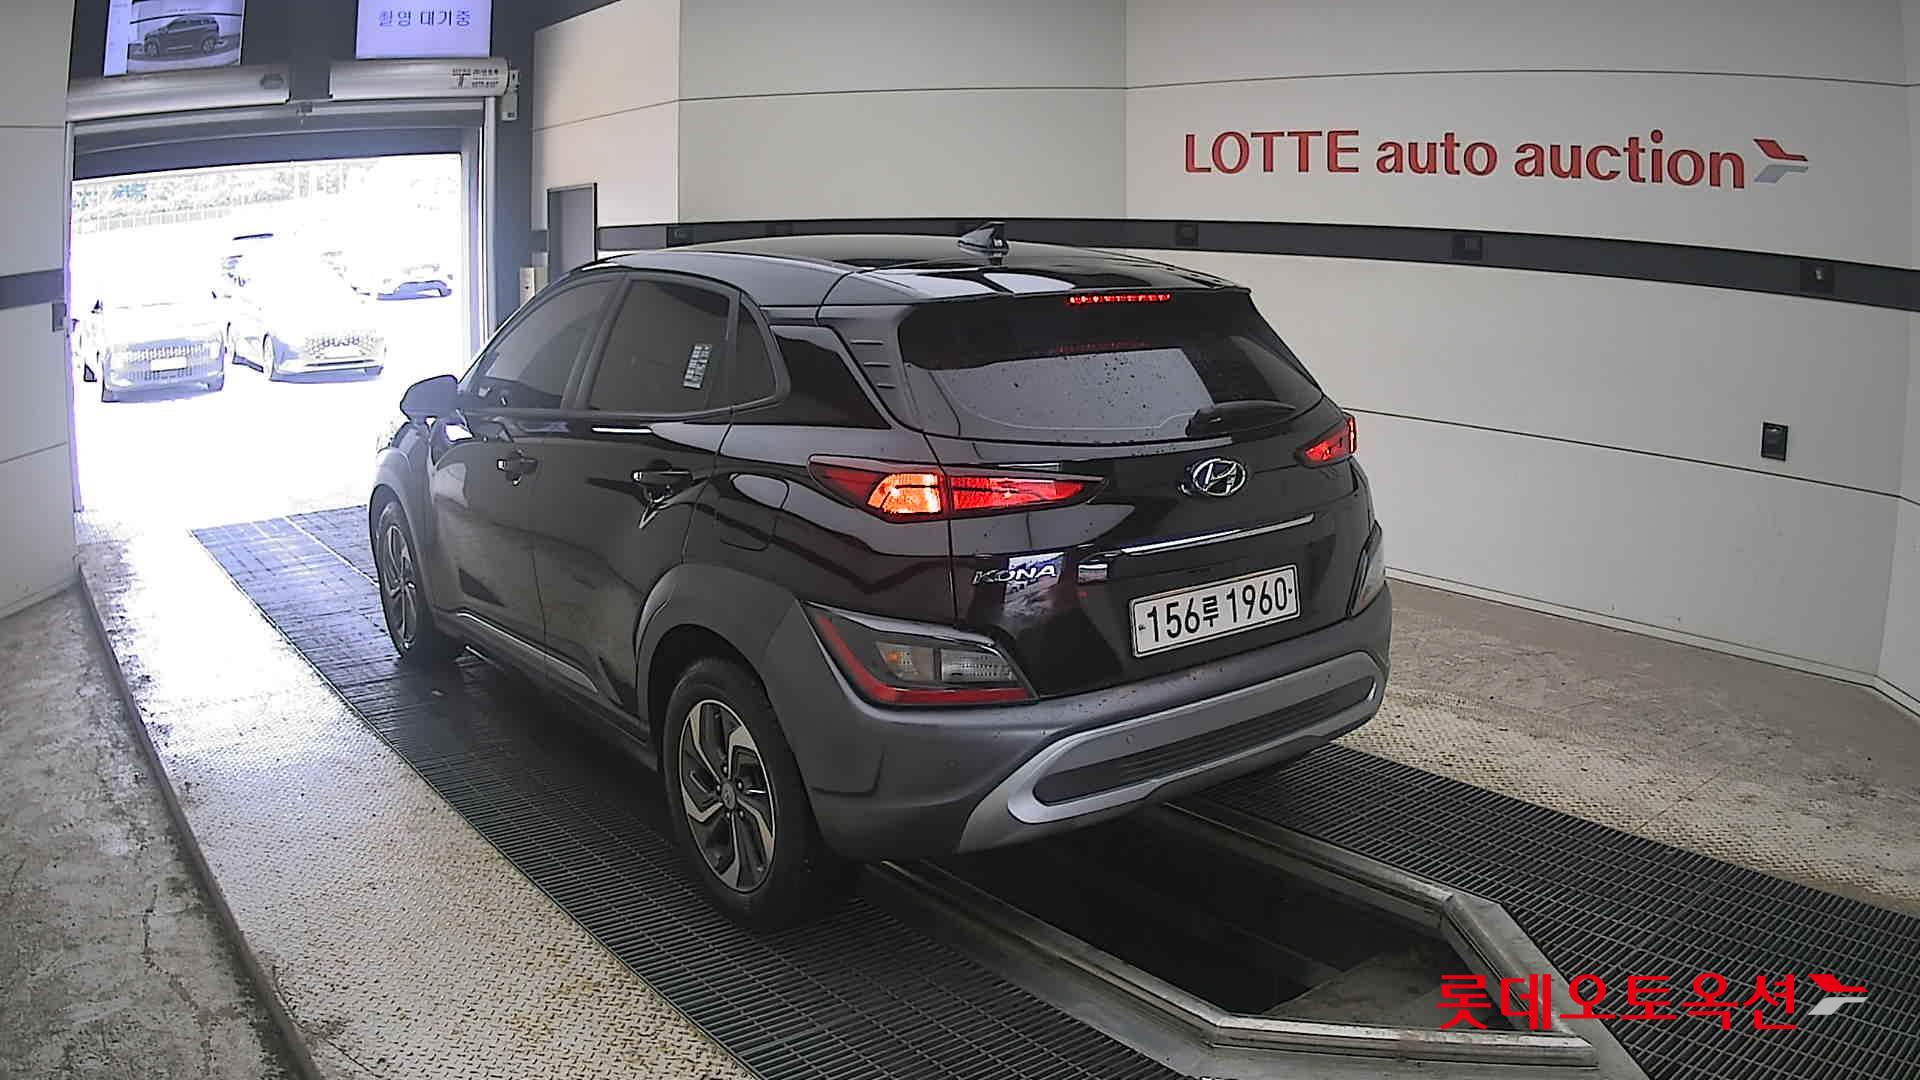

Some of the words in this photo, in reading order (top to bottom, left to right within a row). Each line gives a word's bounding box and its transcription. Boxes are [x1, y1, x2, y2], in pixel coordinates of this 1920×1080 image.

[420, 9, 471, 26] 대기중
[1184, 130, 1359, 174] LOTTE
[1376, 131, 1498, 176] auto
[1514, 129, 1745, 189] auction
[972, 564, 1056, 585] KONA
